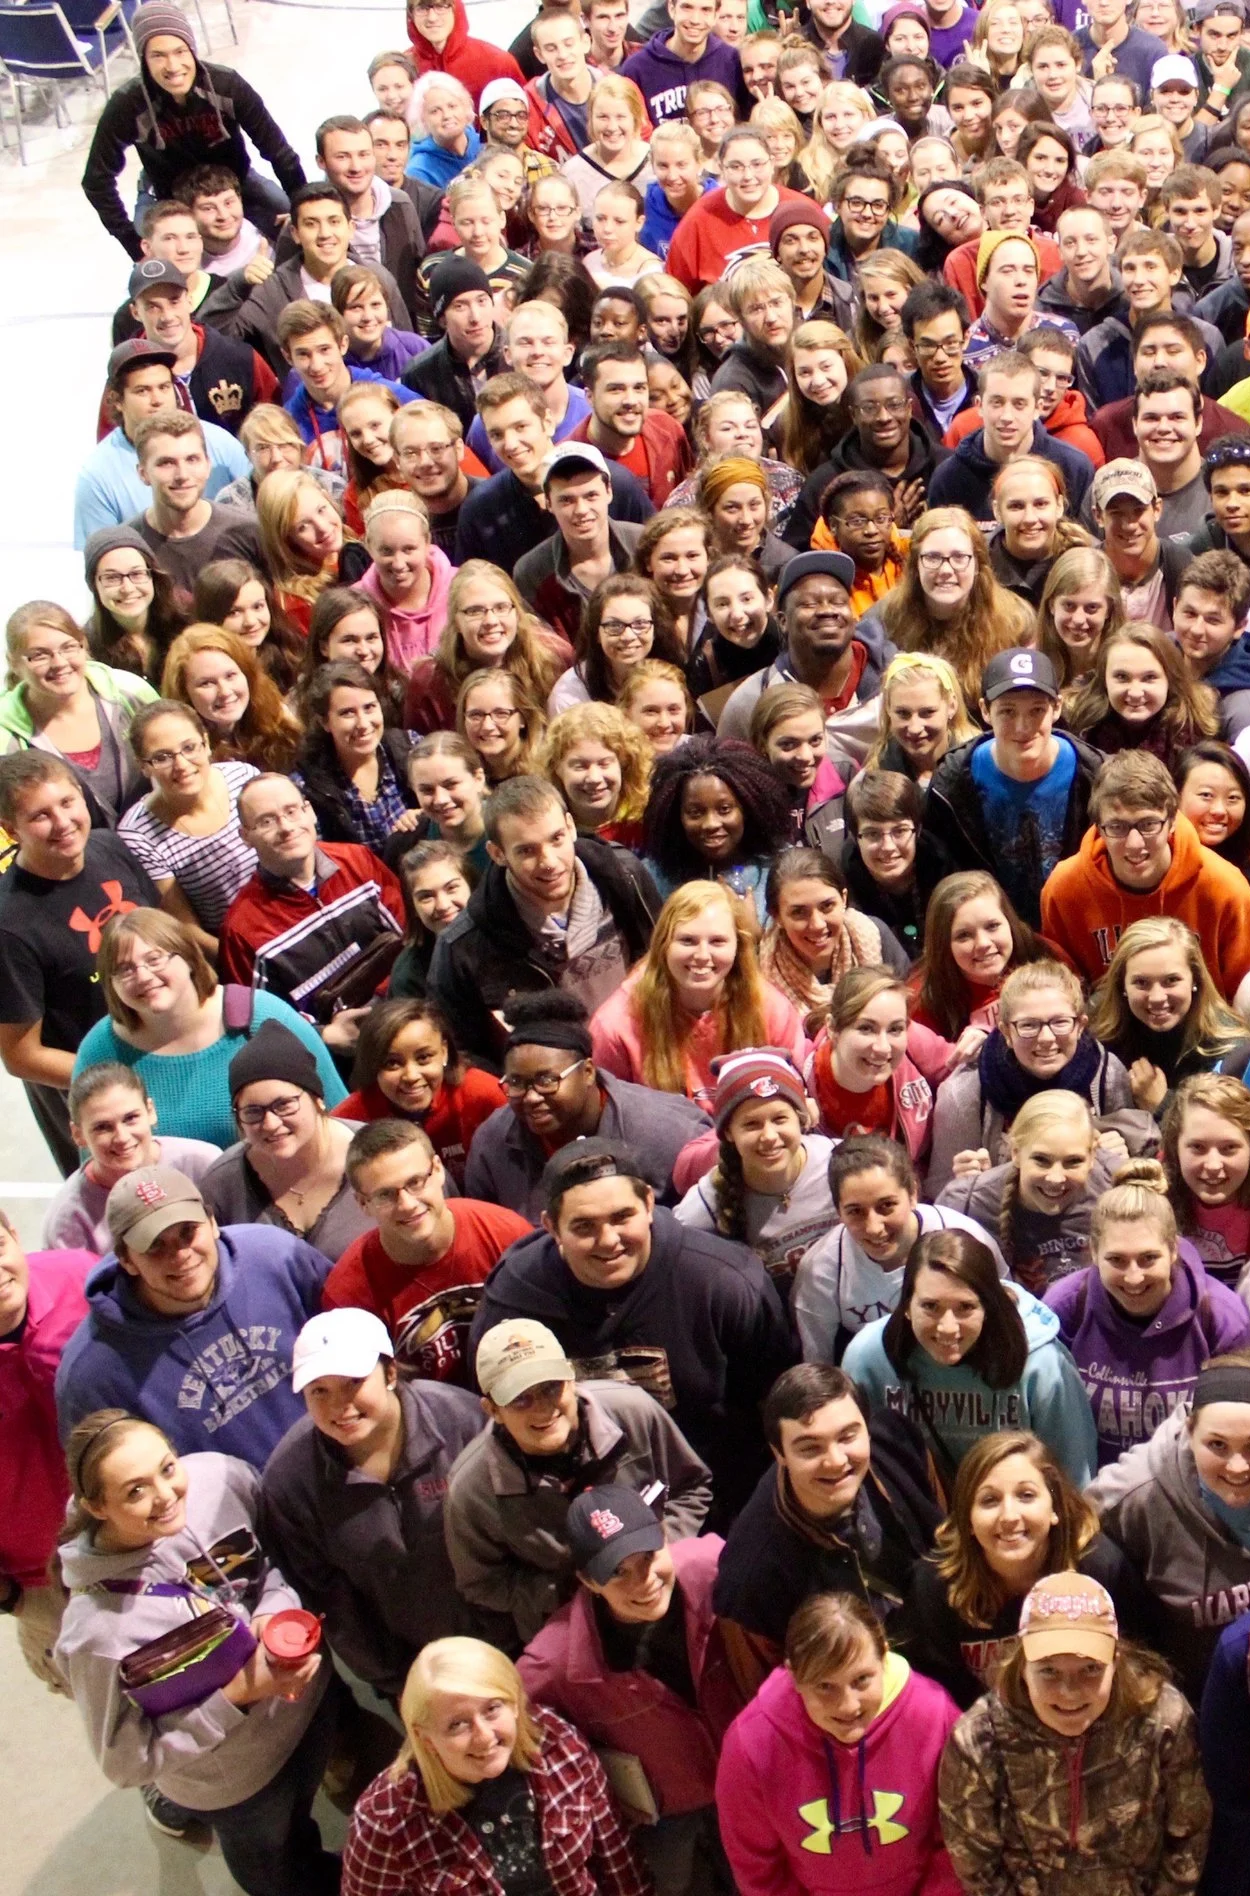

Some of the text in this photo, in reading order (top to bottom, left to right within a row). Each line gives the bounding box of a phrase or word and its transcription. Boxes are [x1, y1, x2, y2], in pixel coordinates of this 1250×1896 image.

[1039, 1236, 1087, 1256] BINGO
[178, 1330, 282, 1410] KENTUCKY
[1088, 1362, 1148, 1387] Collinsville
[886, 1386, 1020, 1426] MARYVILLE
